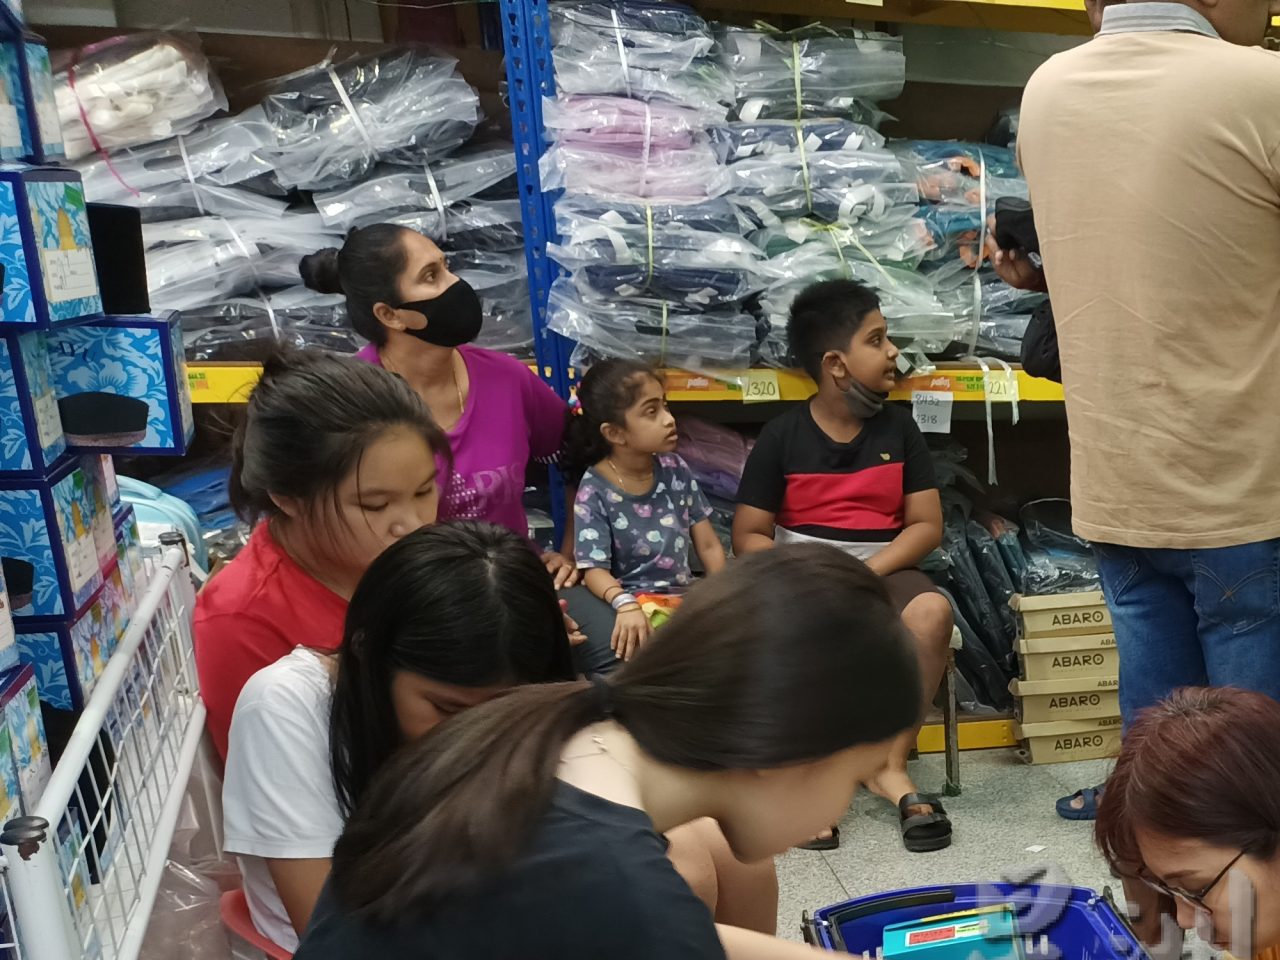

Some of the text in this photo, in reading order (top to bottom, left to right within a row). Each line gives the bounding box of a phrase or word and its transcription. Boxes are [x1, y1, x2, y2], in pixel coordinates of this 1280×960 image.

[1052, 610, 1105, 626] ABARO
[1100, 638, 1117, 646] ABA
[1052, 653, 1105, 668] ABARO
[1049, 694, 1101, 709] ABARO
[1054, 735, 1104, 750] ABARO
